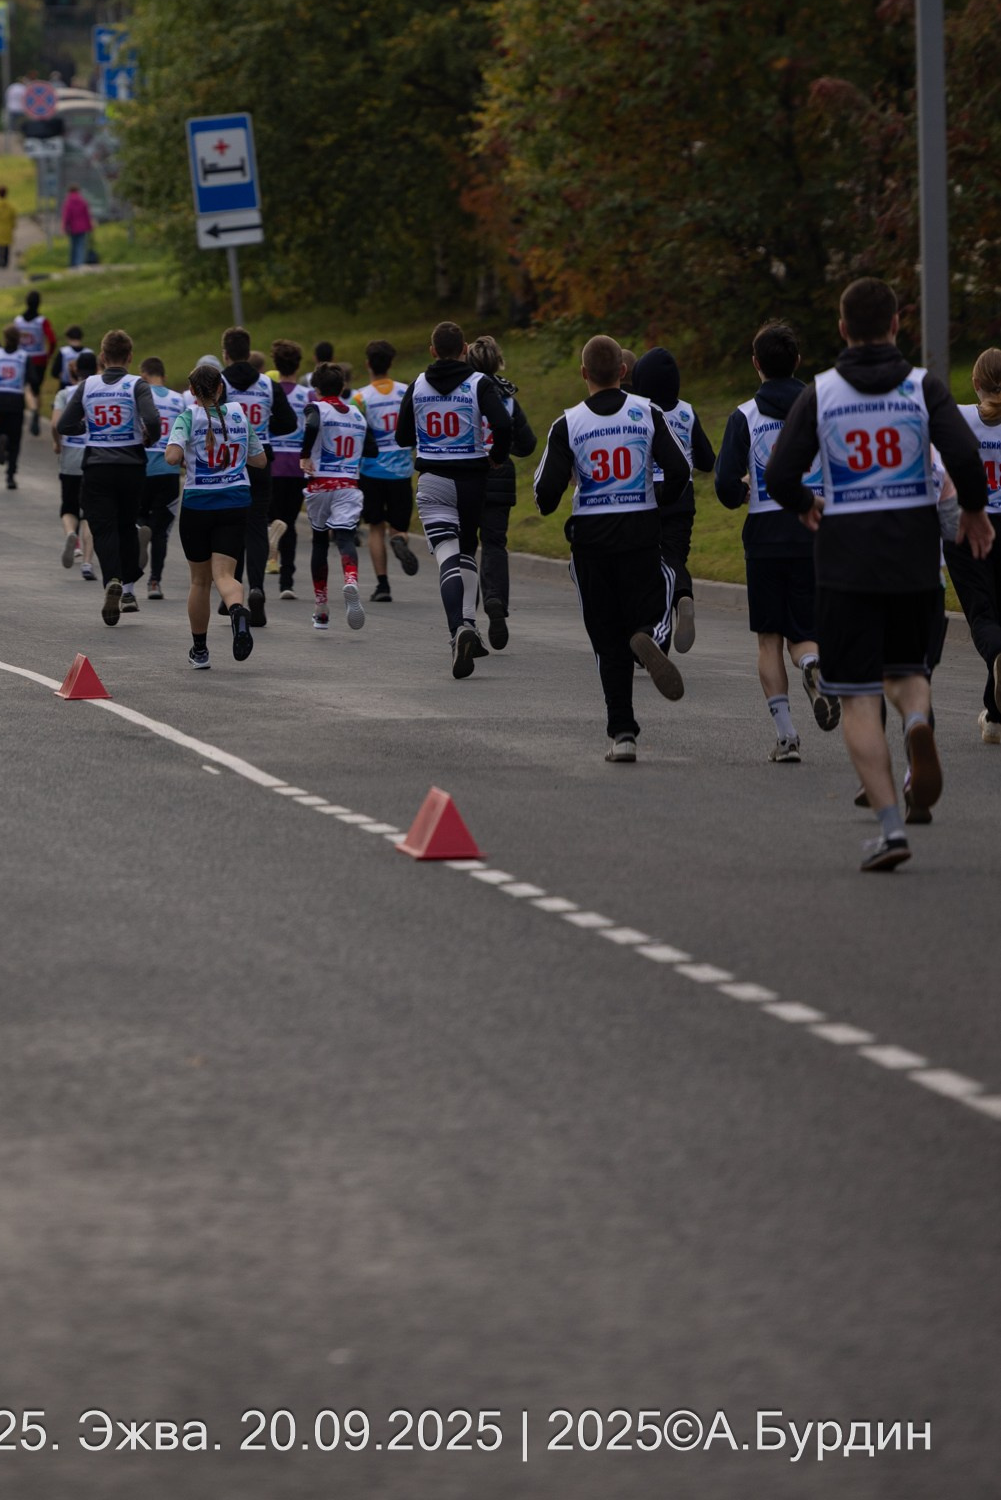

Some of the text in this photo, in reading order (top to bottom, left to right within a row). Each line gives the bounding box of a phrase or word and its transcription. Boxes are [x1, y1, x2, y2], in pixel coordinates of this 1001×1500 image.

[94, 405, 121, 427] 53
[426, 411, 459, 438] 60
[333, 435, 355, 459] 10
[574, 424, 648, 446] ЭЖВИНСКИЙ РАЙОН
[204, 443, 240, 469] 147
[845, 427, 902, 472] 38
[590, 446, 632, 483] 30
[984, 461, 1001, 490] 4
